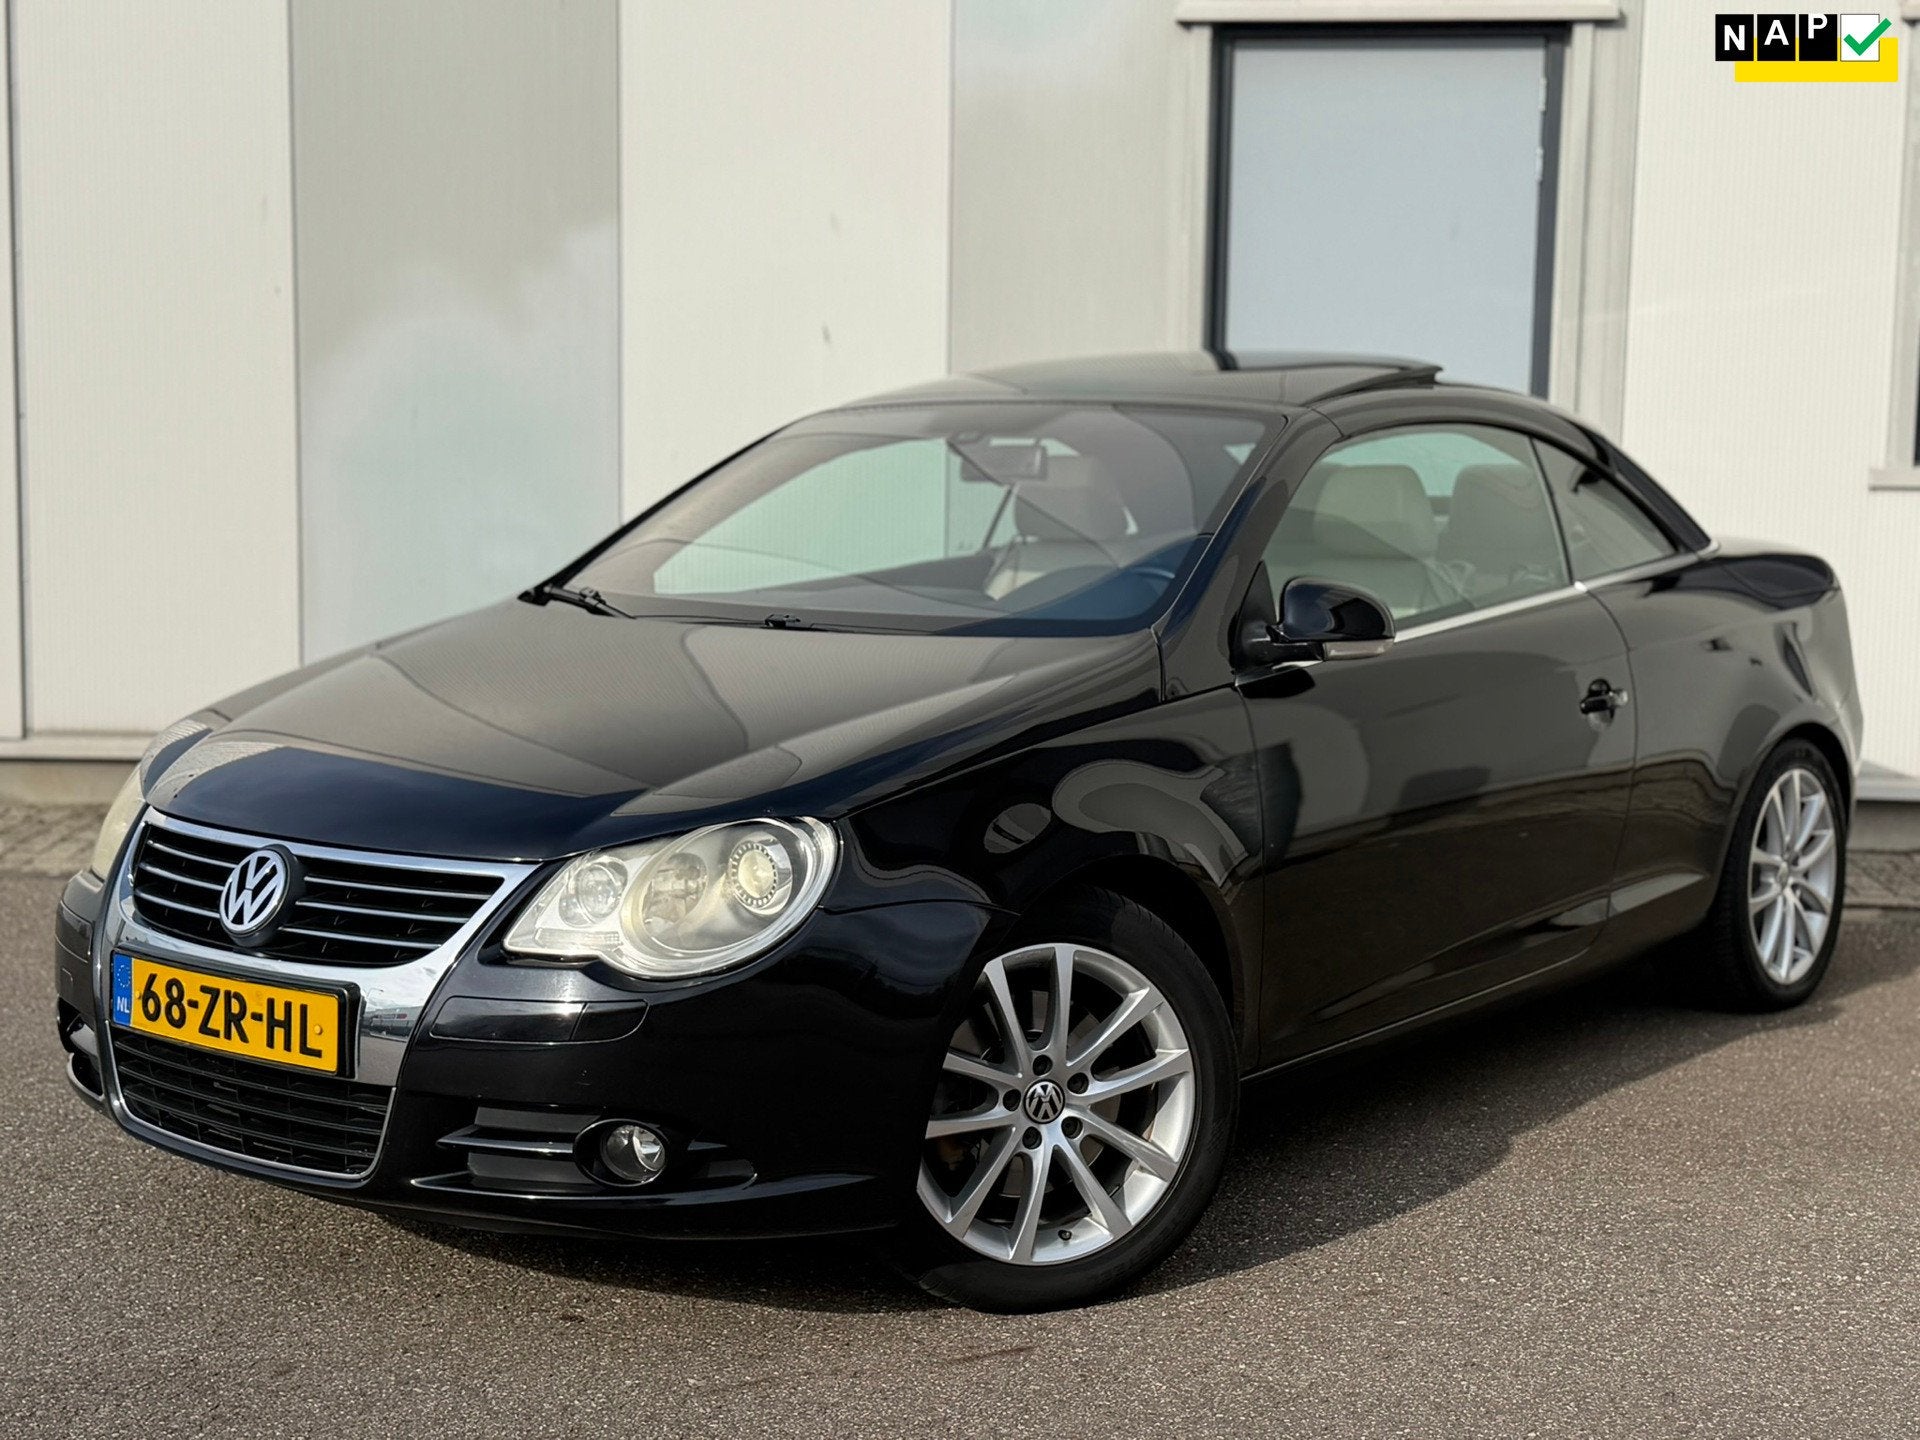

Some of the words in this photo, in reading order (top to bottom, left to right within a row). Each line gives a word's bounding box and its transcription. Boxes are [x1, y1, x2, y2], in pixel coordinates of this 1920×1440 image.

[223, 851, 284, 929] VW
[116, 996, 130, 1014] NL
[141, 973, 323, 1059] 68-ZR-HL
[1026, 1082, 1063, 1122] VW
